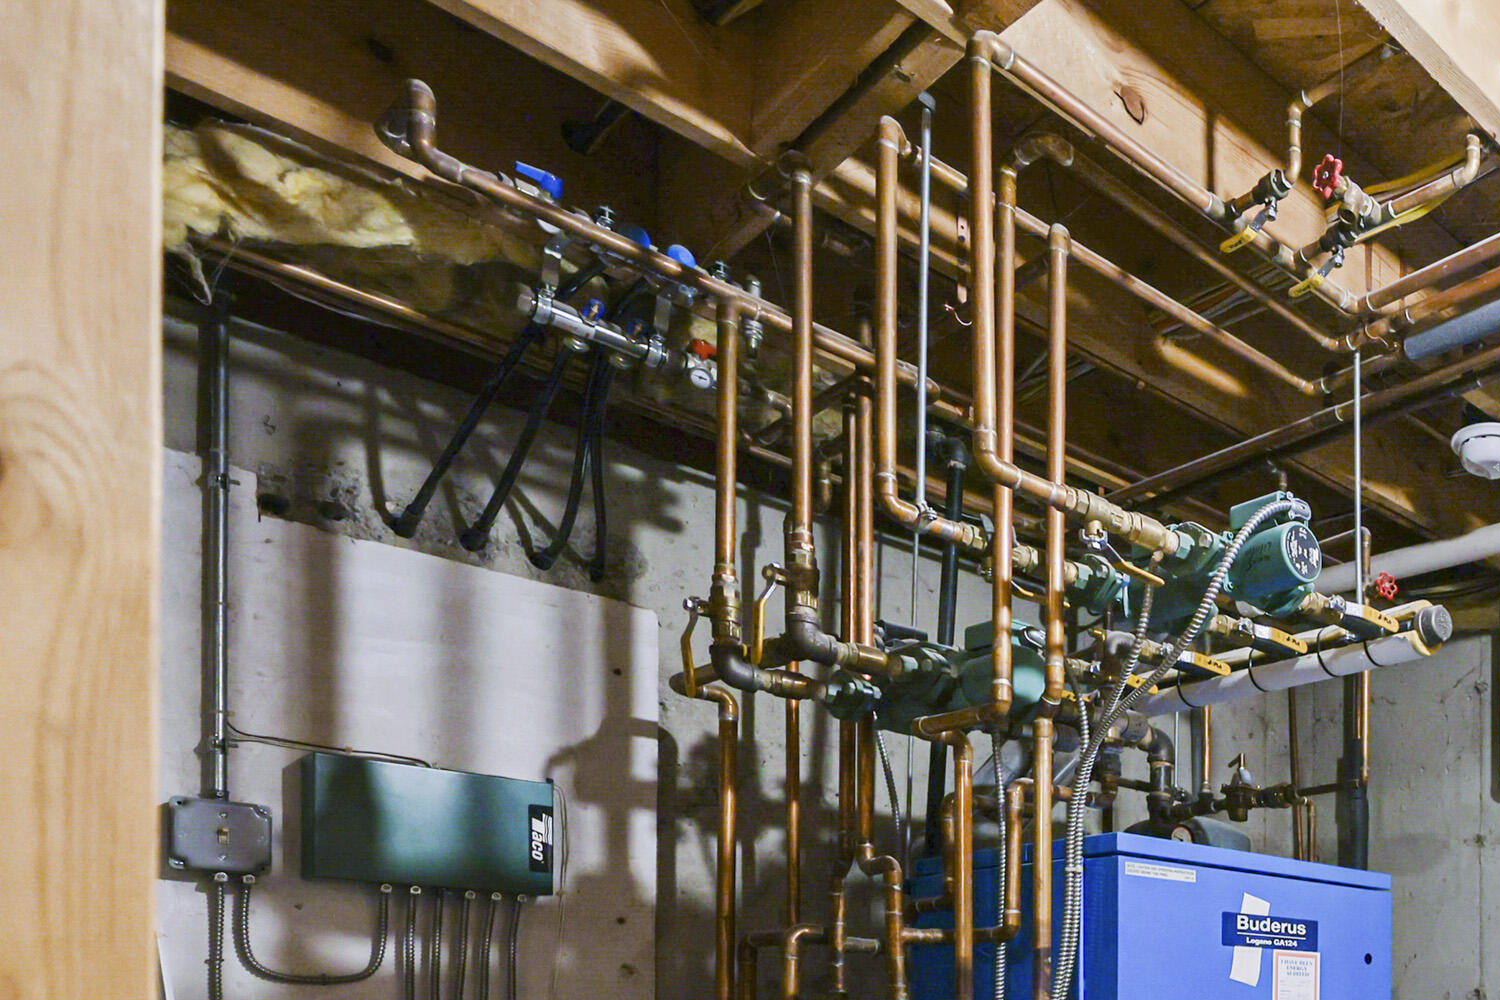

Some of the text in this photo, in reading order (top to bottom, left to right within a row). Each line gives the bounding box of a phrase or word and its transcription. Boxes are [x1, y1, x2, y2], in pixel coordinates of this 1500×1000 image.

[531, 813, 553, 862] Taco
[1237, 914, 1307, 936] Buderus
[1246, 936, 1298, 948] Logano GA124
